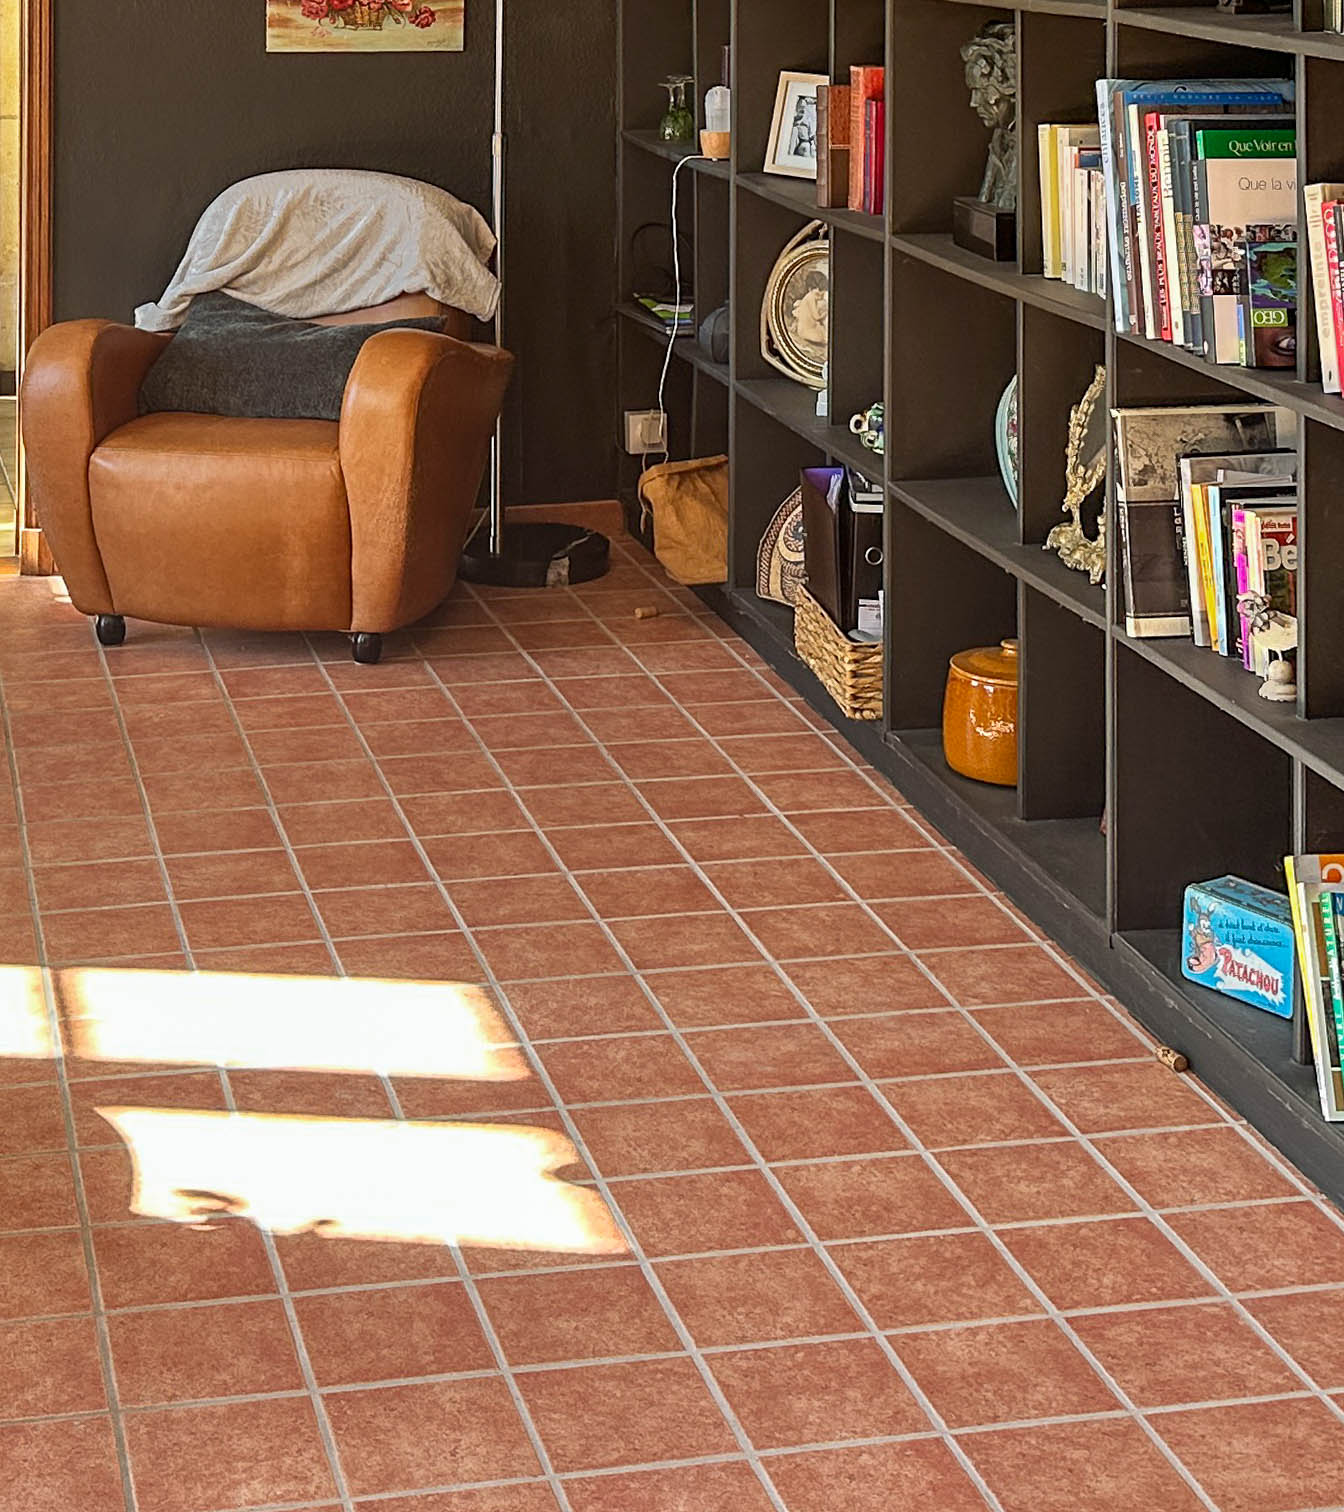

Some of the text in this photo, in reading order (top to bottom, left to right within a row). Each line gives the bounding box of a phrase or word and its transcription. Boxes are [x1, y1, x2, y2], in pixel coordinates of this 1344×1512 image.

[1147, 128, 1157, 166] MONDE
[1228, 139, 1292, 156] Que Voir en
[1161, 140, 1173, 199] Renoir
[1238, 177, 1266, 192] Que
[1271, 177, 1282, 191] la
[1253, 311, 1286, 324] GEO
[1218, 948, 1279, 996] PATACHOU
